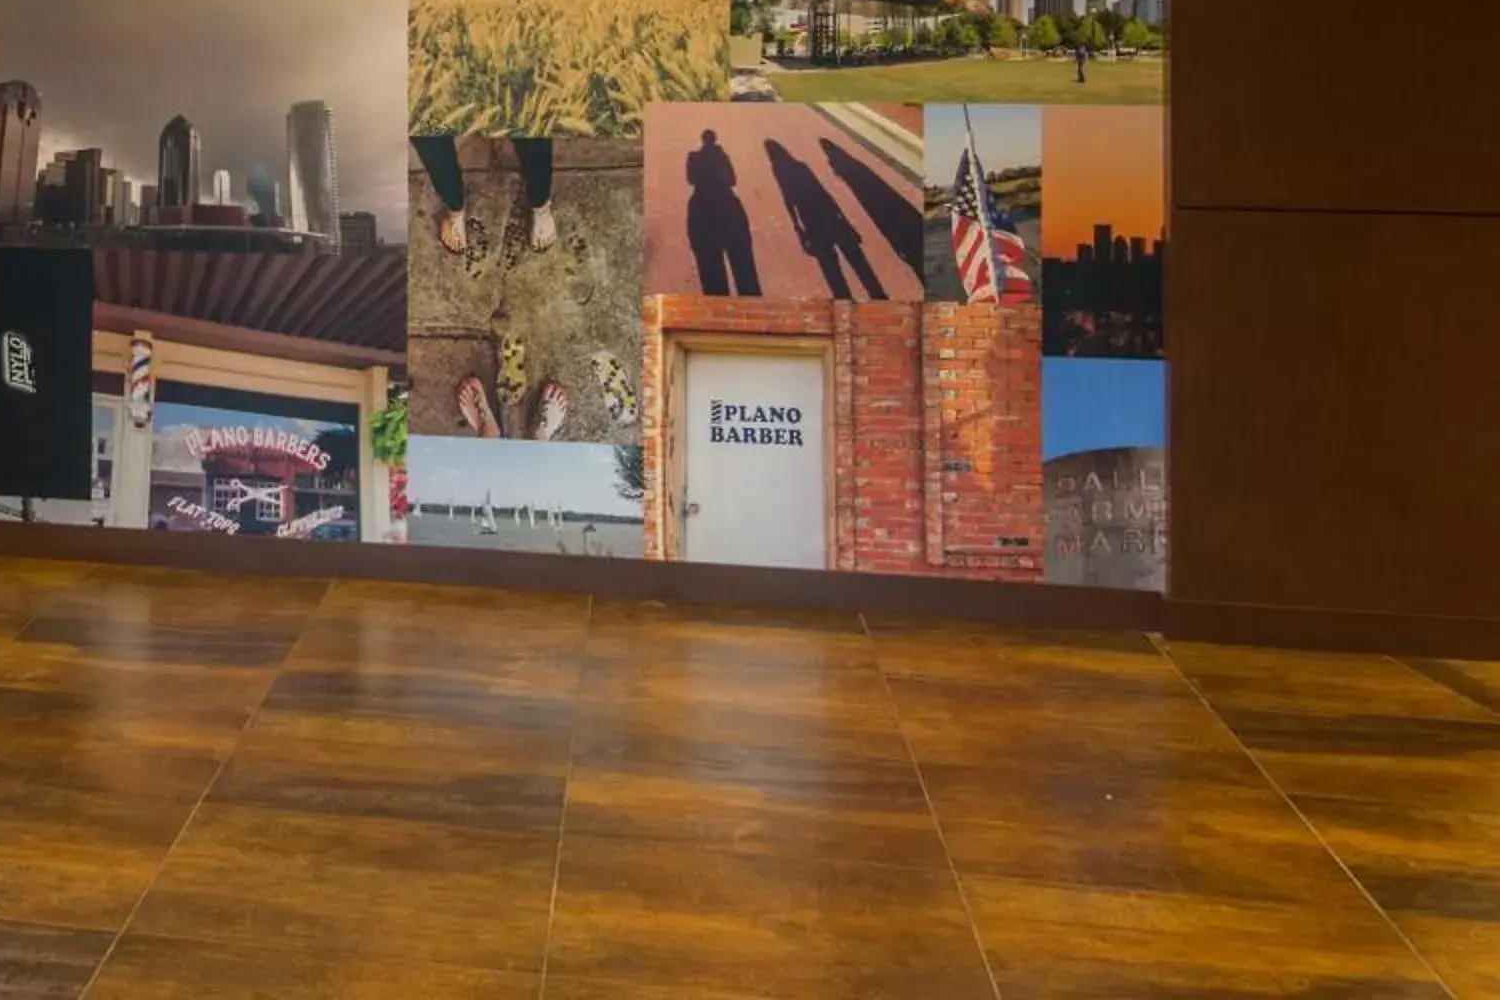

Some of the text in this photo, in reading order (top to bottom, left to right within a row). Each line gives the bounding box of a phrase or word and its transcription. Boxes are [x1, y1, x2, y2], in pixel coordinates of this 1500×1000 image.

[724, 404, 803, 425] PLANO
[710, 425, 804, 447] BARBER
[252, 426, 331, 471] BARBERS
